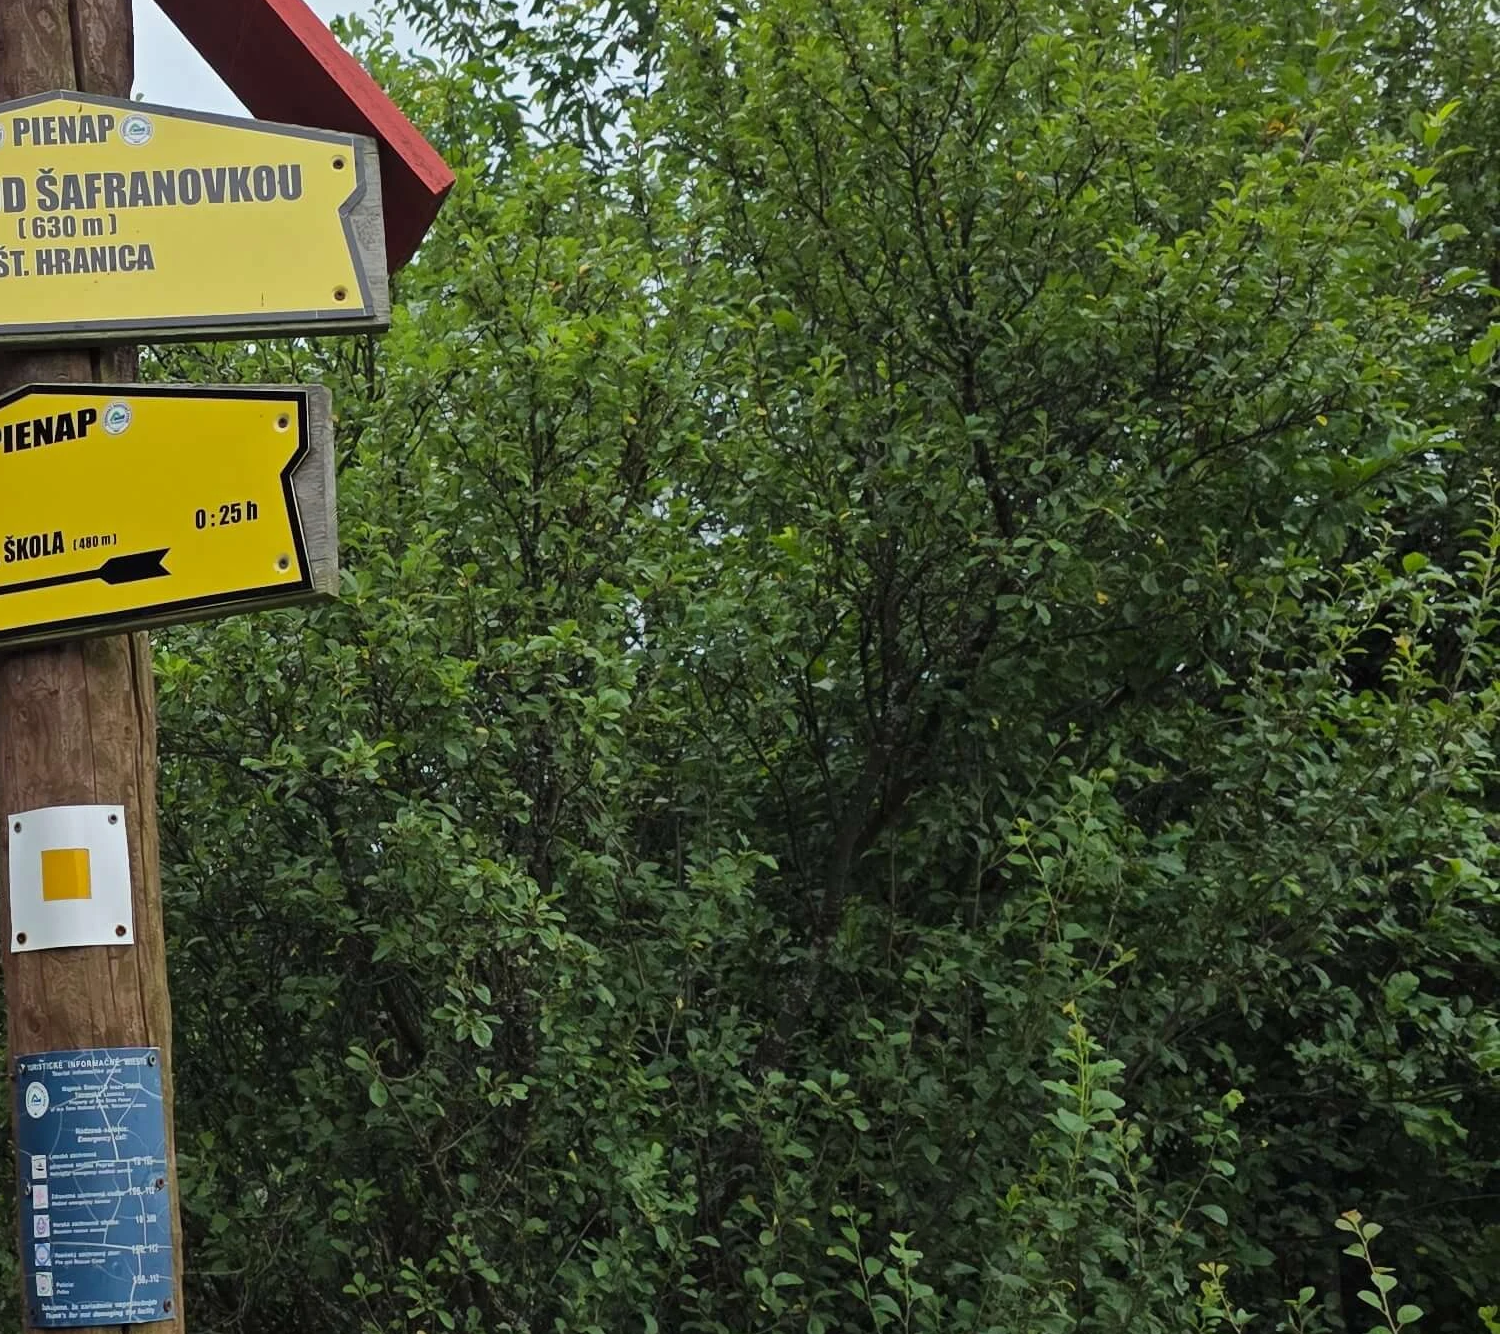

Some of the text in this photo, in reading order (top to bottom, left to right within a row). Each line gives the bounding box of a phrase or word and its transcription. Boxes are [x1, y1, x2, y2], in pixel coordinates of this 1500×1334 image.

[12, 113, 115, 147] PIENAP
[37, 163, 303, 212] ŠAFRANOVKOU
[35, 244, 155, 276] HRANICA
[3, 531, 65, 564] ŠKOLA
